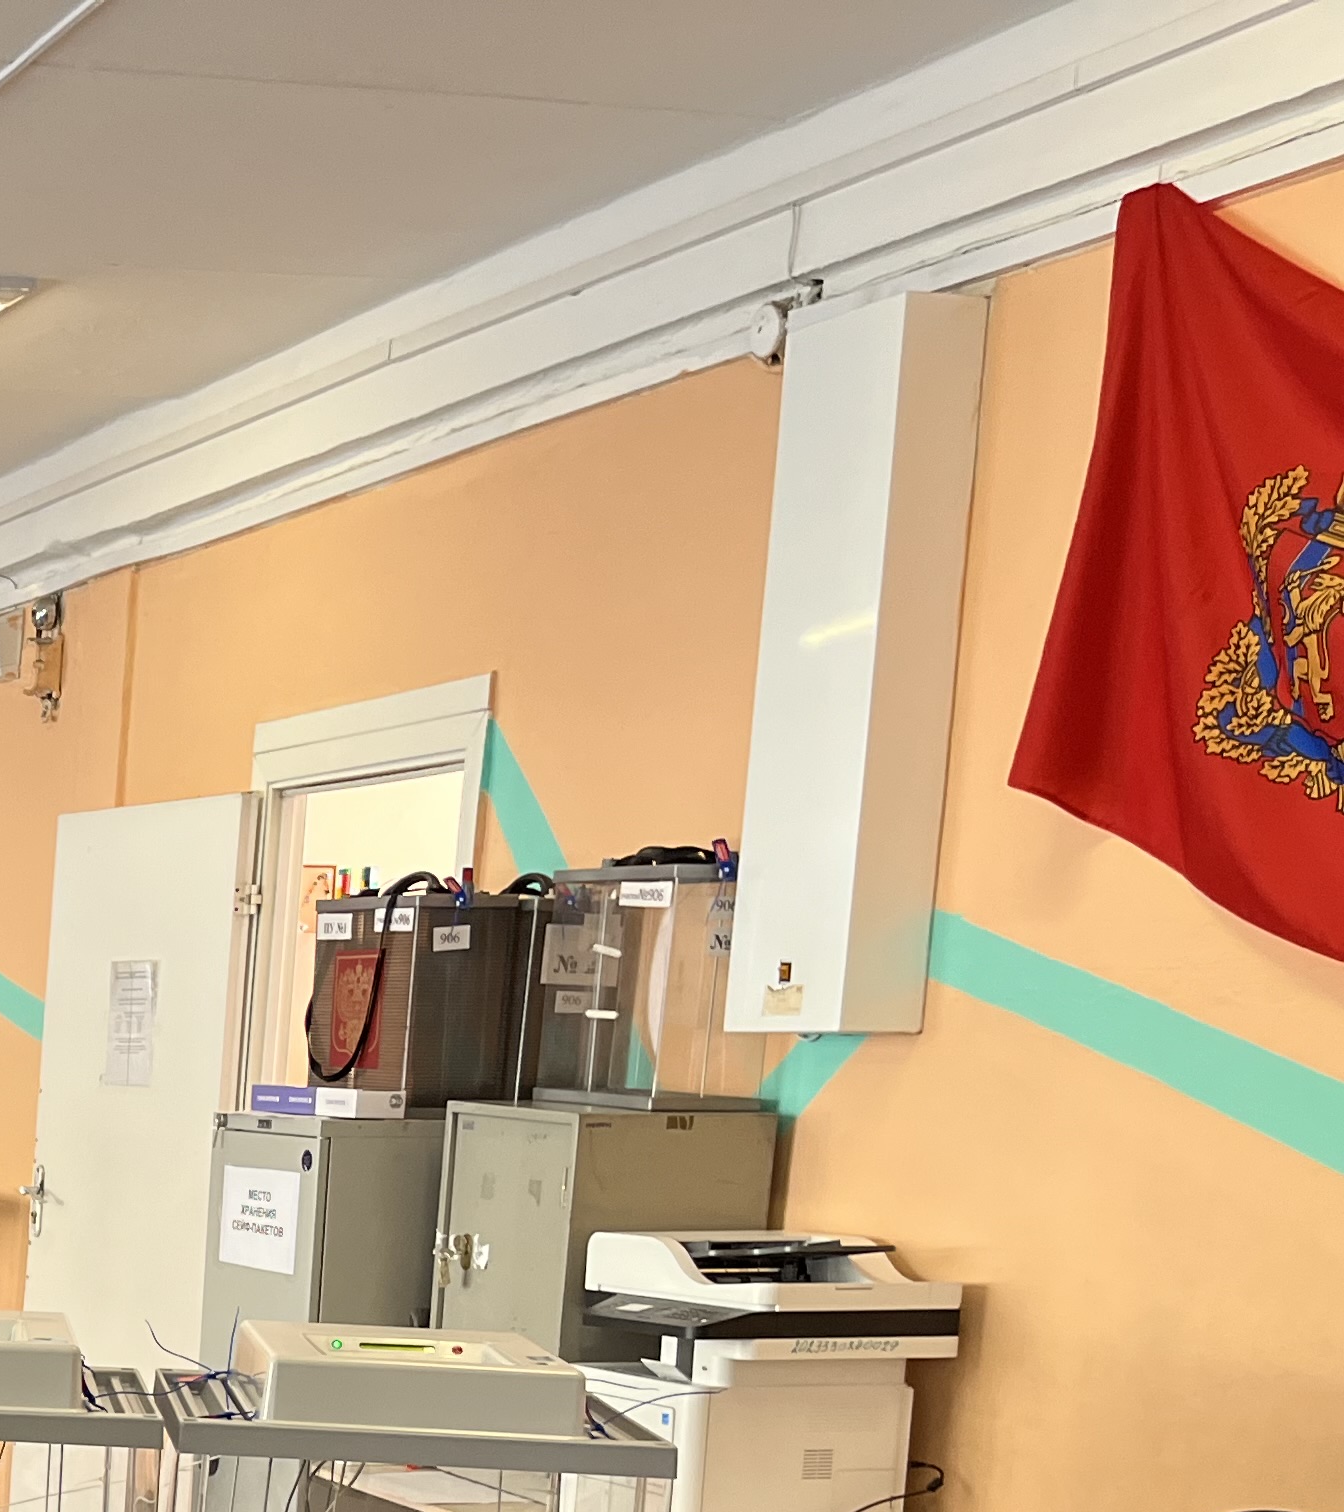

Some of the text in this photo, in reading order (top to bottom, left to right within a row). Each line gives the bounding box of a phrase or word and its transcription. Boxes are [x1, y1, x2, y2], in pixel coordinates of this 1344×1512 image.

[440, 932, 461, 944] 906
[562, 995, 582, 1007] 906
[248, 1189, 272, 1202] МЕСТО
[240, 1204, 277, 1220] ХРАНЕНИЯ
[232, 1219, 284, 1238] СЕЙФ-ПАКЕТОВ
